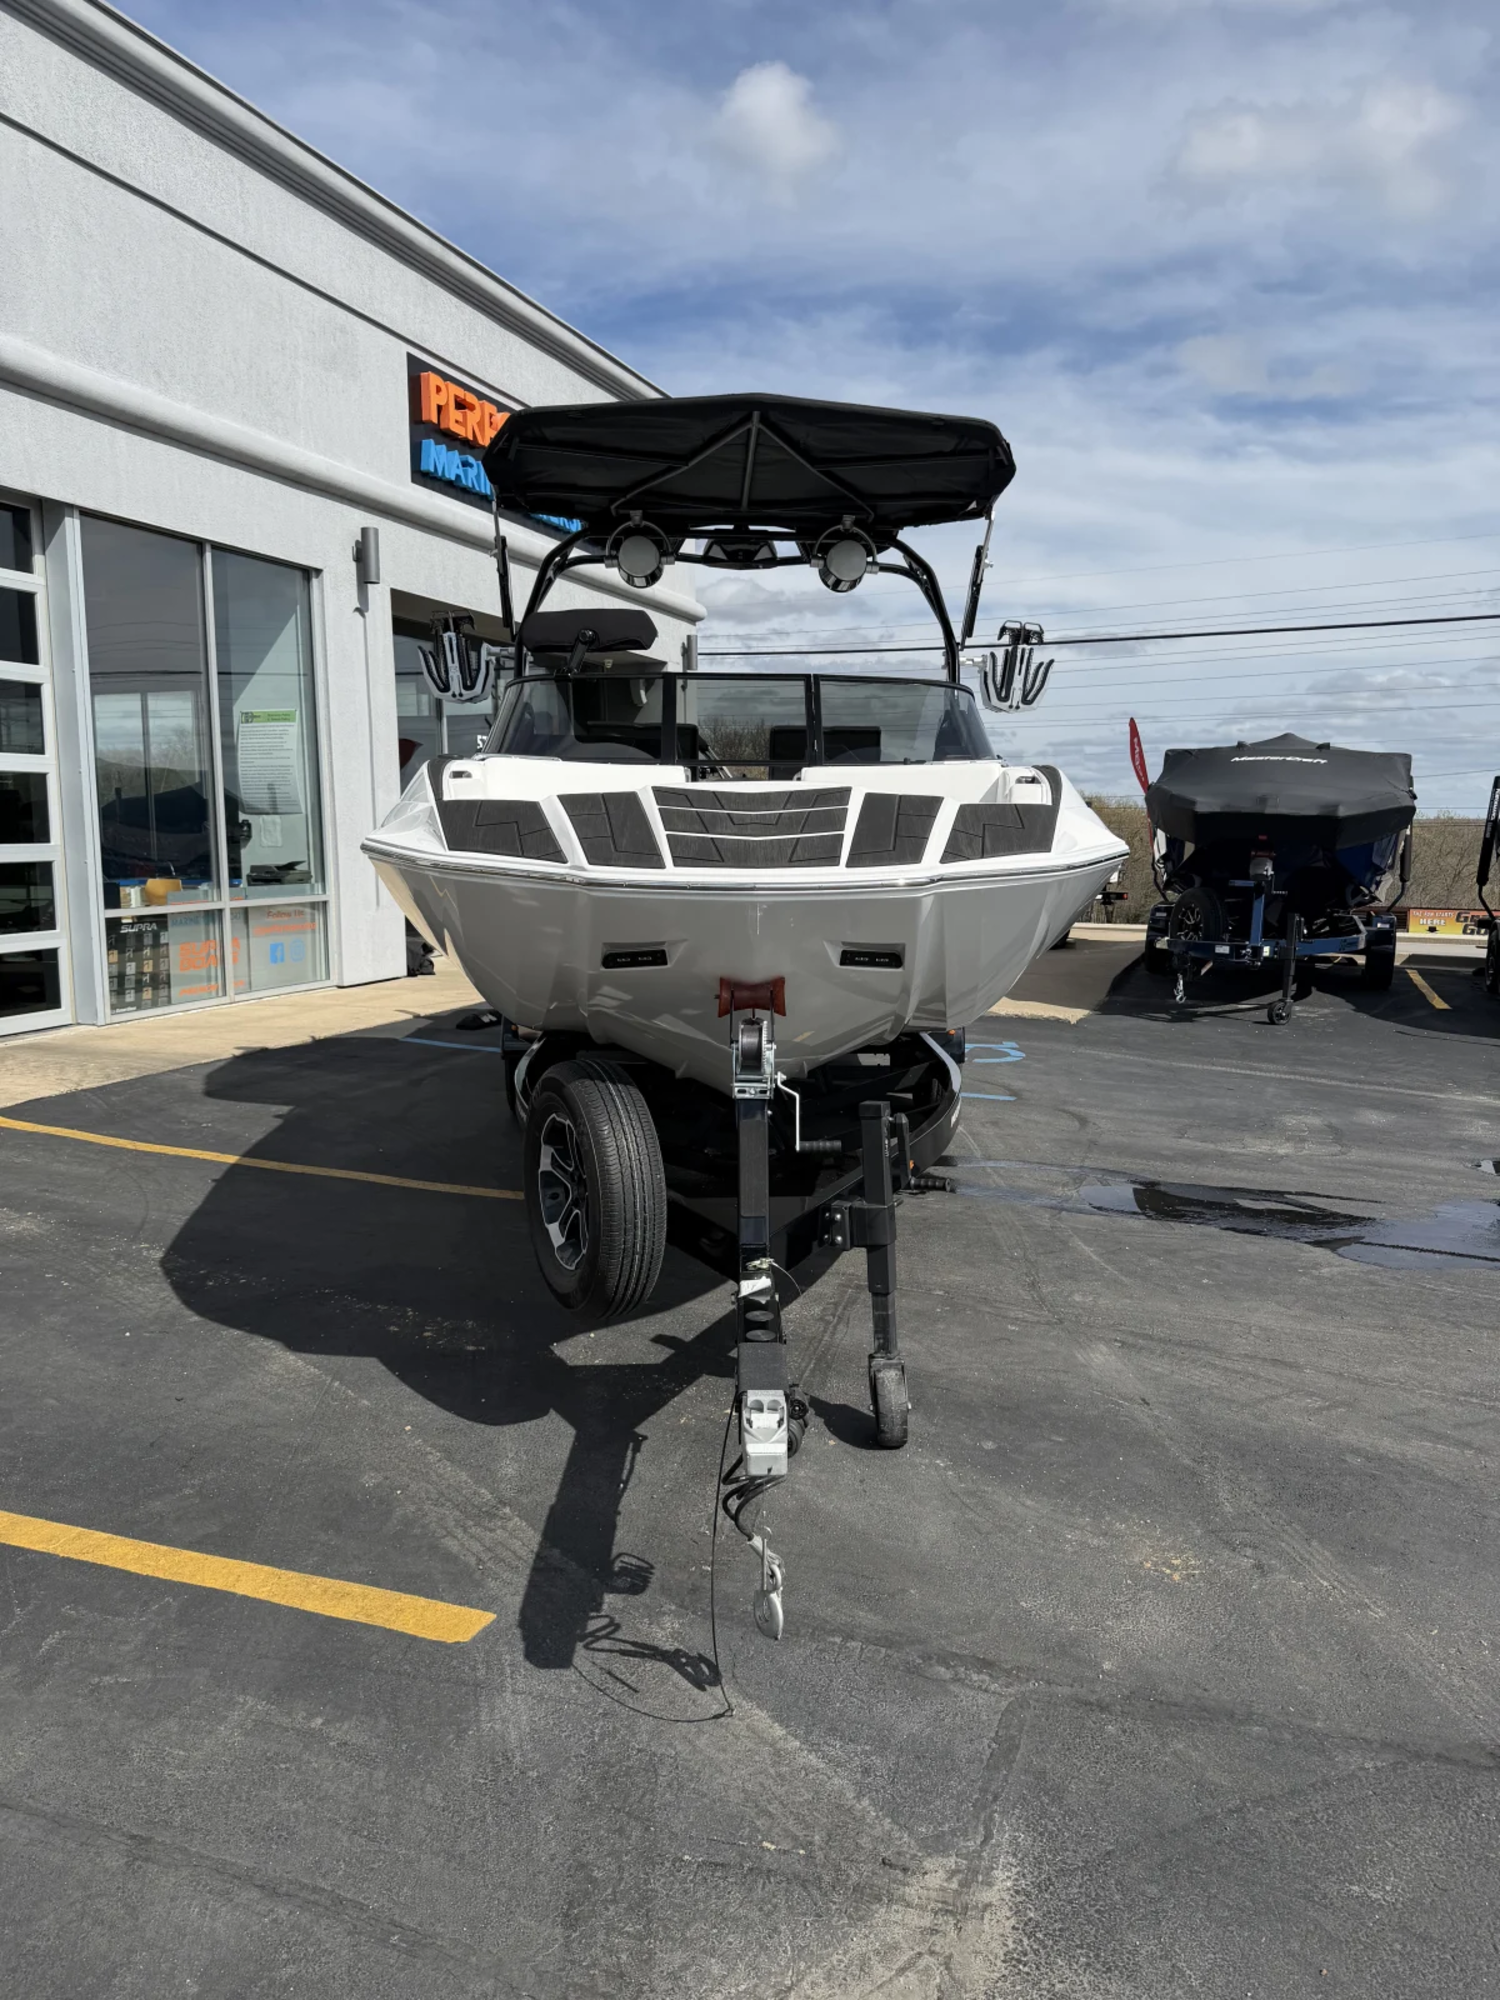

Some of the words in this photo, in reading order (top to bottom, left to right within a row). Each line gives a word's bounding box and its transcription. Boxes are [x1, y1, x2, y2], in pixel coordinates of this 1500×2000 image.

[420, 439, 495, 497] MARI
[267, 910, 291, 919] Follow
[120, 922, 157, 933] SUPRA
